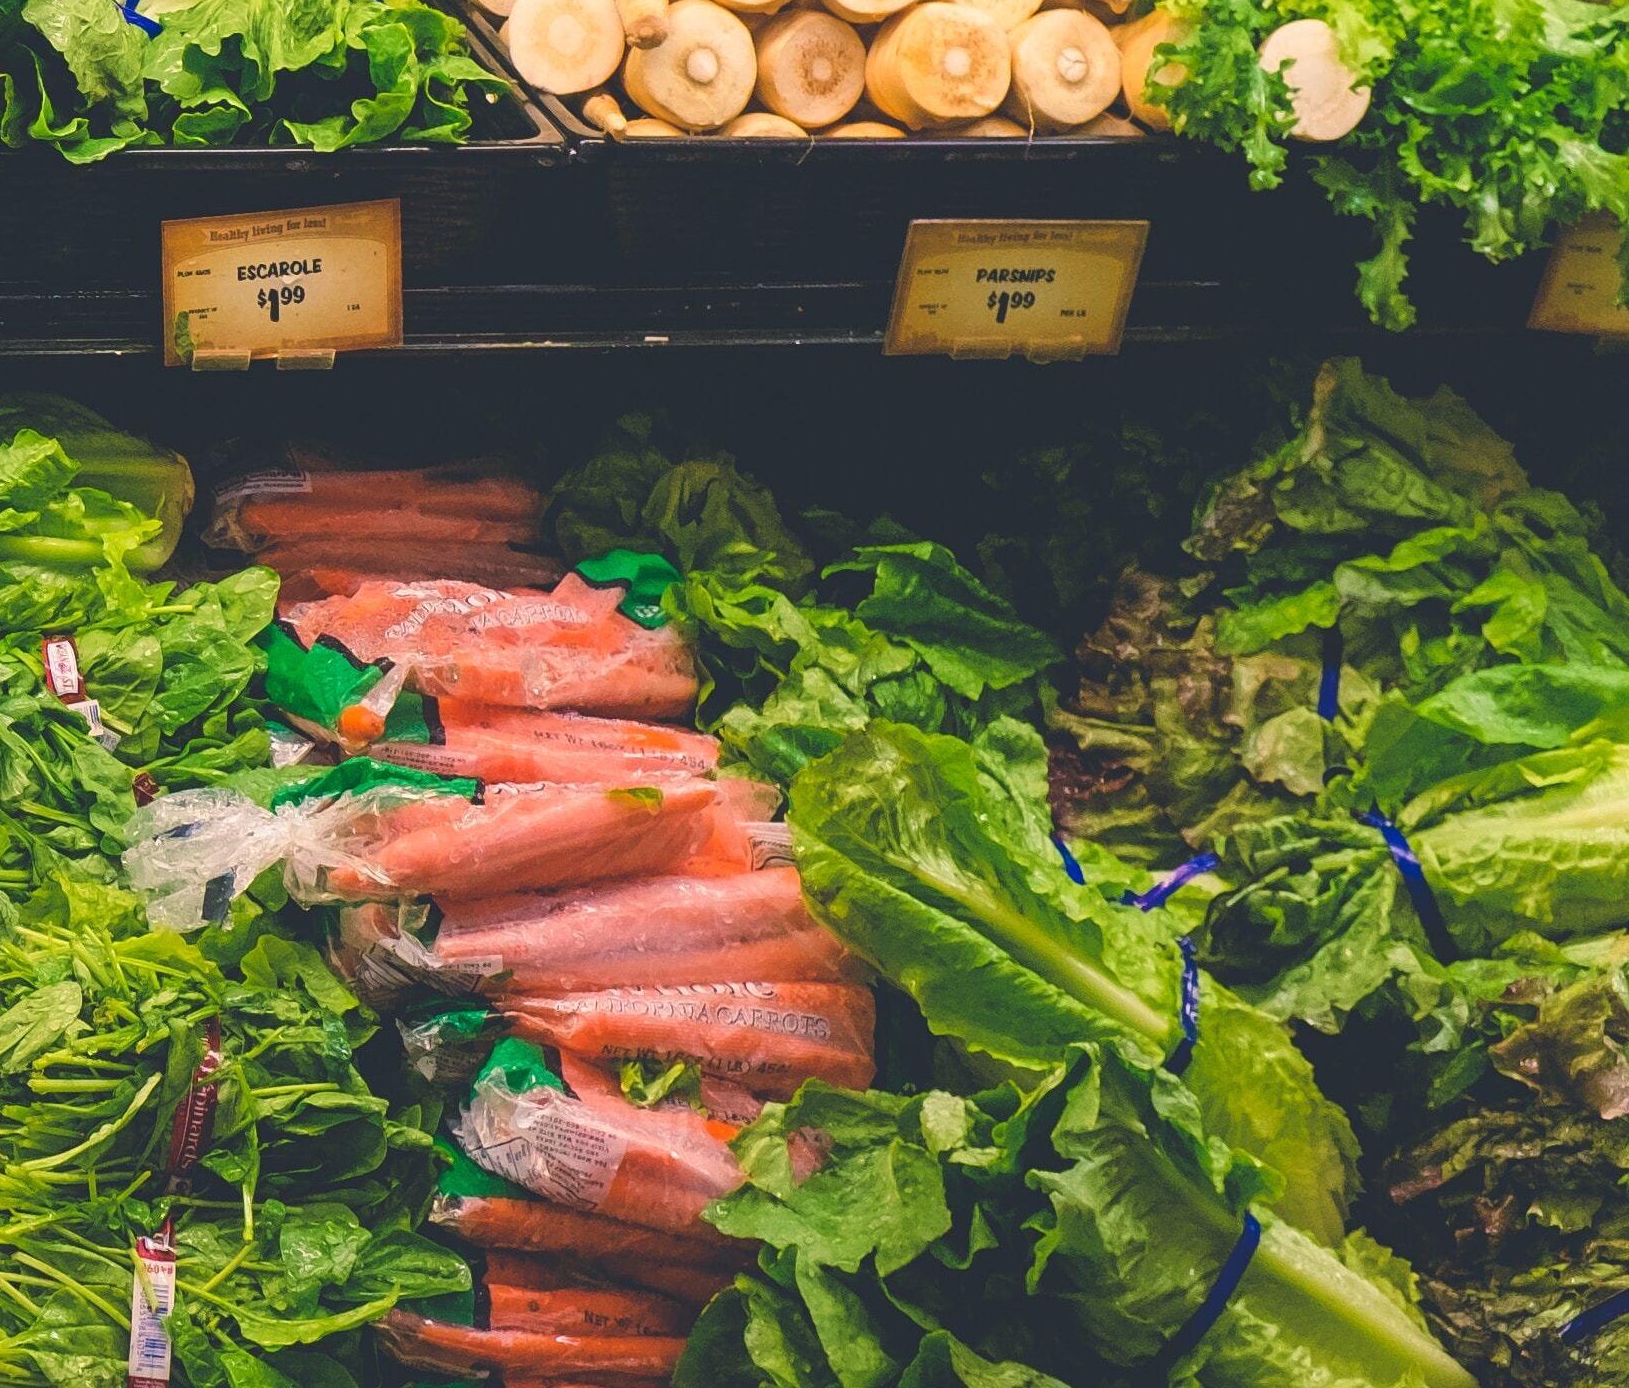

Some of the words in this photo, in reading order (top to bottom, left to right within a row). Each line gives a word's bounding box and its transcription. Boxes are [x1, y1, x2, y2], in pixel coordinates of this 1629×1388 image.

[286, 219, 301, 231] for
[237, 258, 323, 282] ESCAROLE
[975, 268, 1057, 284] PARSNIPS
[717, 1006, 830, 1038] CARROTS
[603, 1044, 631, 1057] NET
